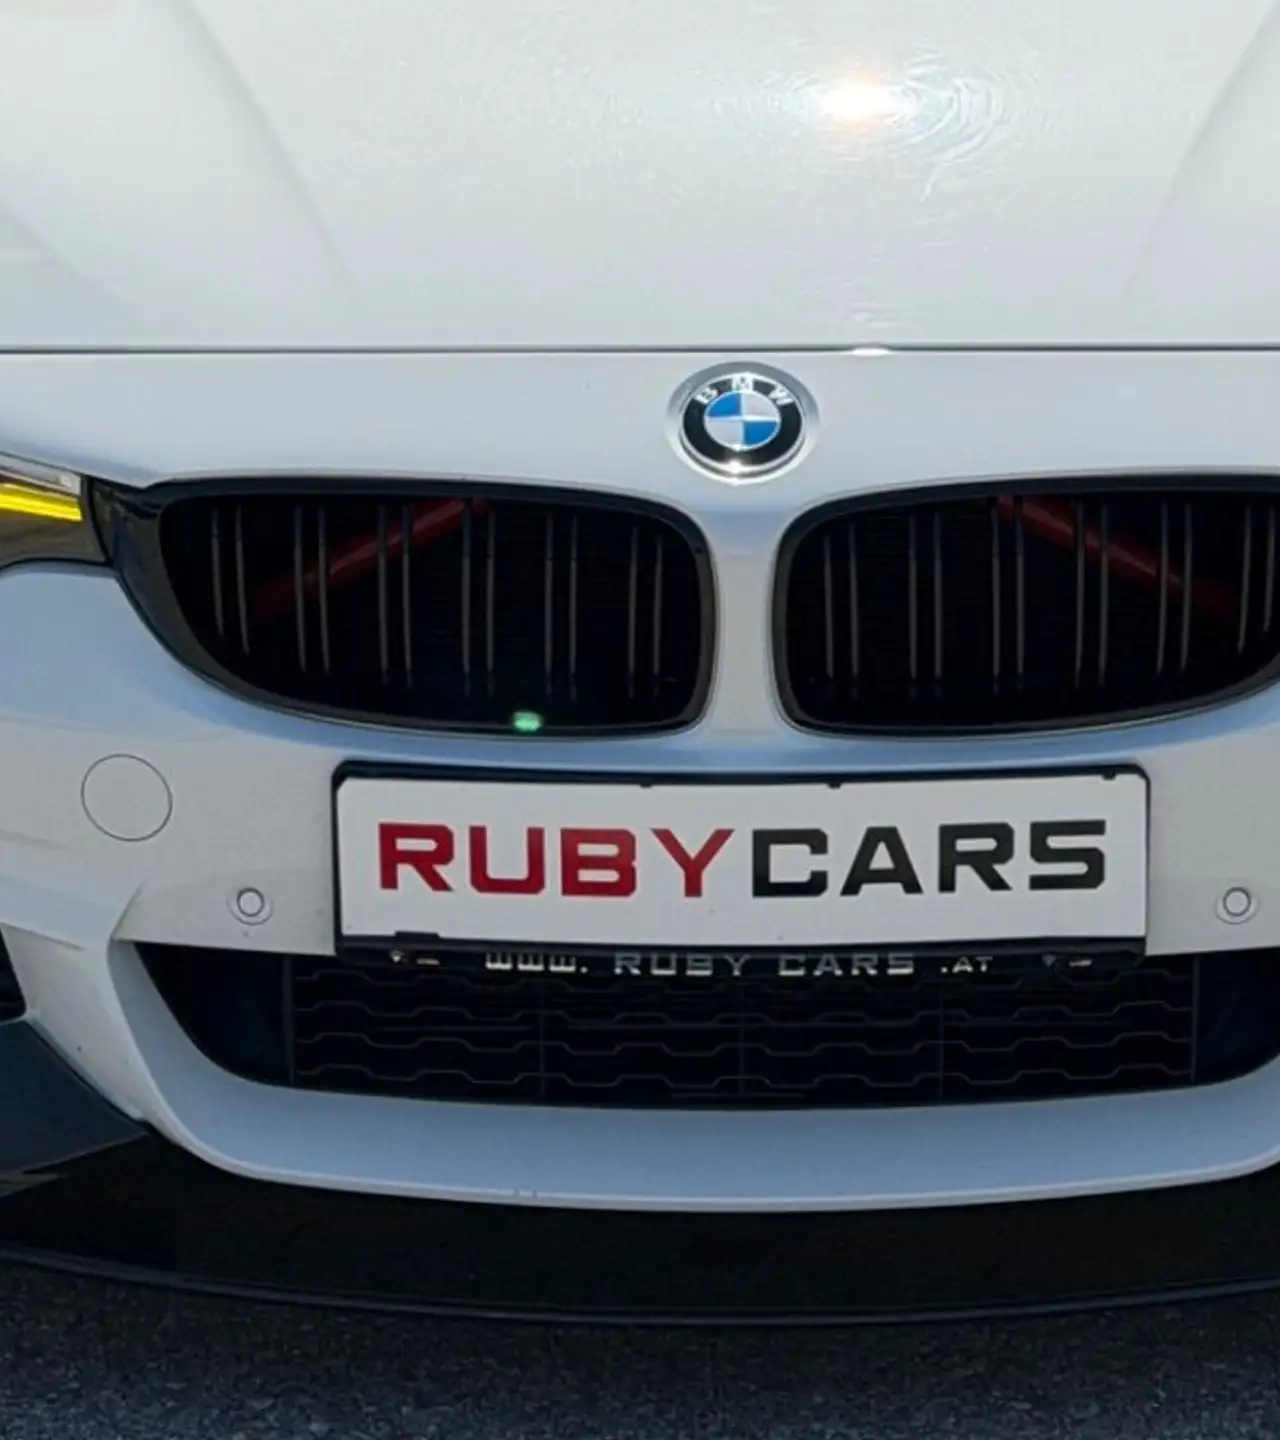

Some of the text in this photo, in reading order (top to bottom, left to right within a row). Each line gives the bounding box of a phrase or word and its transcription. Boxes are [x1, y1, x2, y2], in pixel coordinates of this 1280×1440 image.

[694, 373, 794, 407] BMW
[378, 820, 1107, 898] RUBYCARS
[614, 952, 752, 976] RUBY
[777, 952, 916, 976] CARS
